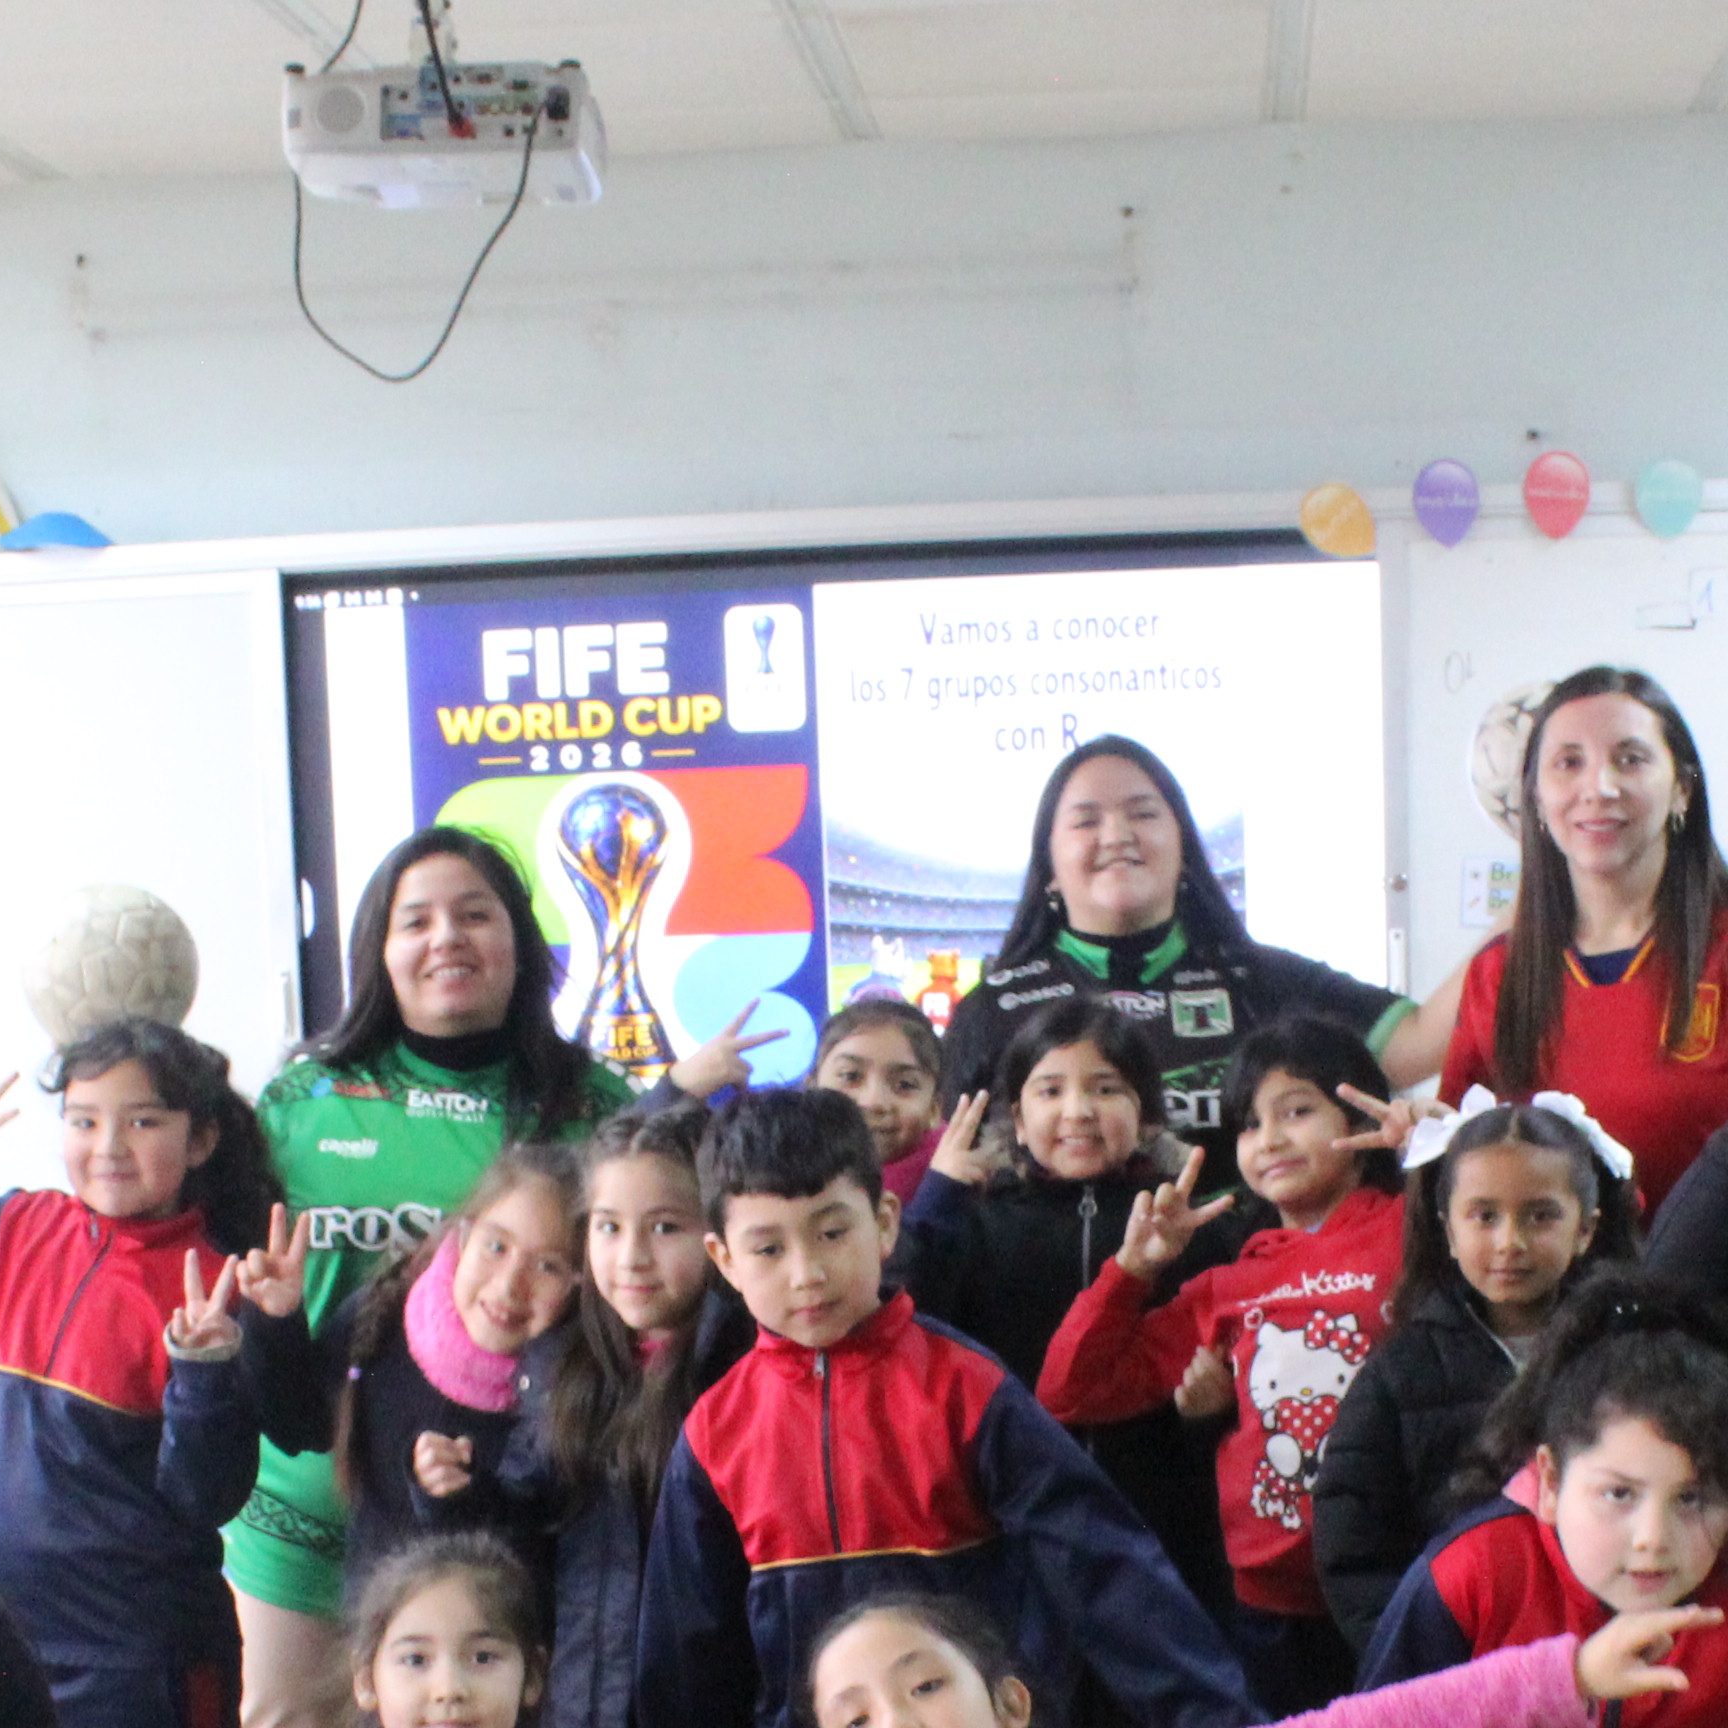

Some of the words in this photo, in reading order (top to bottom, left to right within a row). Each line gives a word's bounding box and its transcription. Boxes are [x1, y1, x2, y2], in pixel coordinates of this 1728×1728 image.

[919, 612, 1012, 645] Vamos
[1025, 618, 1040, 642] a
[1052, 613, 1159, 641] conocer
[482, 621, 670, 702] FIFE
[850, 669, 887, 703] los
[900, 667, 915, 701] 7
[927, 670, 1017, 711] grupos
[1030, 662, 1222, 697] consonanticos
[437, 703, 615, 745] WORLD
[624, 694, 723, 735] CUP
[995, 725, 1046, 752] con
[529, 741, 643, 772] 2026
[407, 1088, 489, 1113] EASTON
[1302, 1269, 1377, 1297] Kitty
